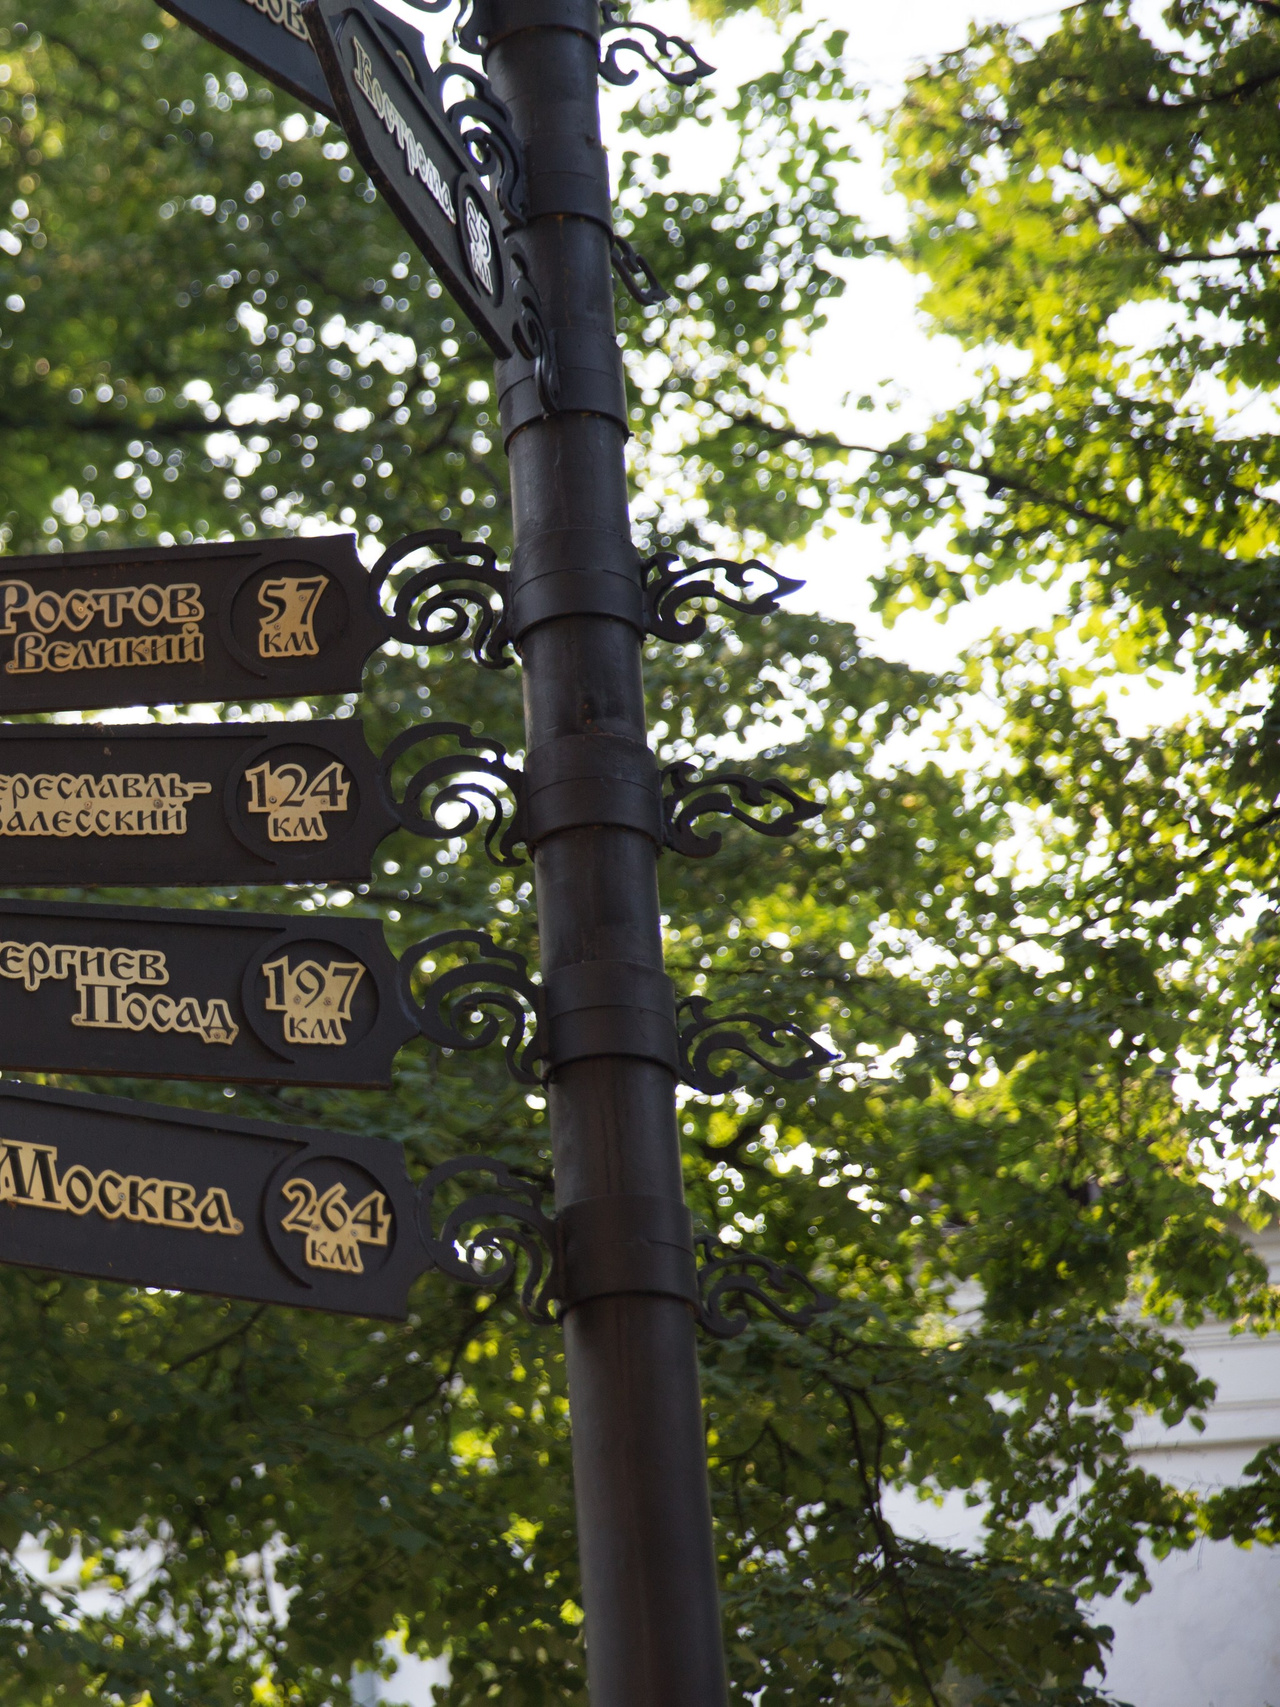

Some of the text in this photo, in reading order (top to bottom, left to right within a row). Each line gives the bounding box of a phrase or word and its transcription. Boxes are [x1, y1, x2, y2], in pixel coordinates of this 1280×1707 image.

[354, 37, 455, 223] Кострома
[466, 198, 490, 261] 85
[260, 577, 327, 627] 57
[8, 626, 203, 672] Великий
[247, 763, 349, 811] 124
[74, 983, 237, 1043] Посад
[265, 957, 365, 1015] 197
[283, 1179, 390, 1244] 264
